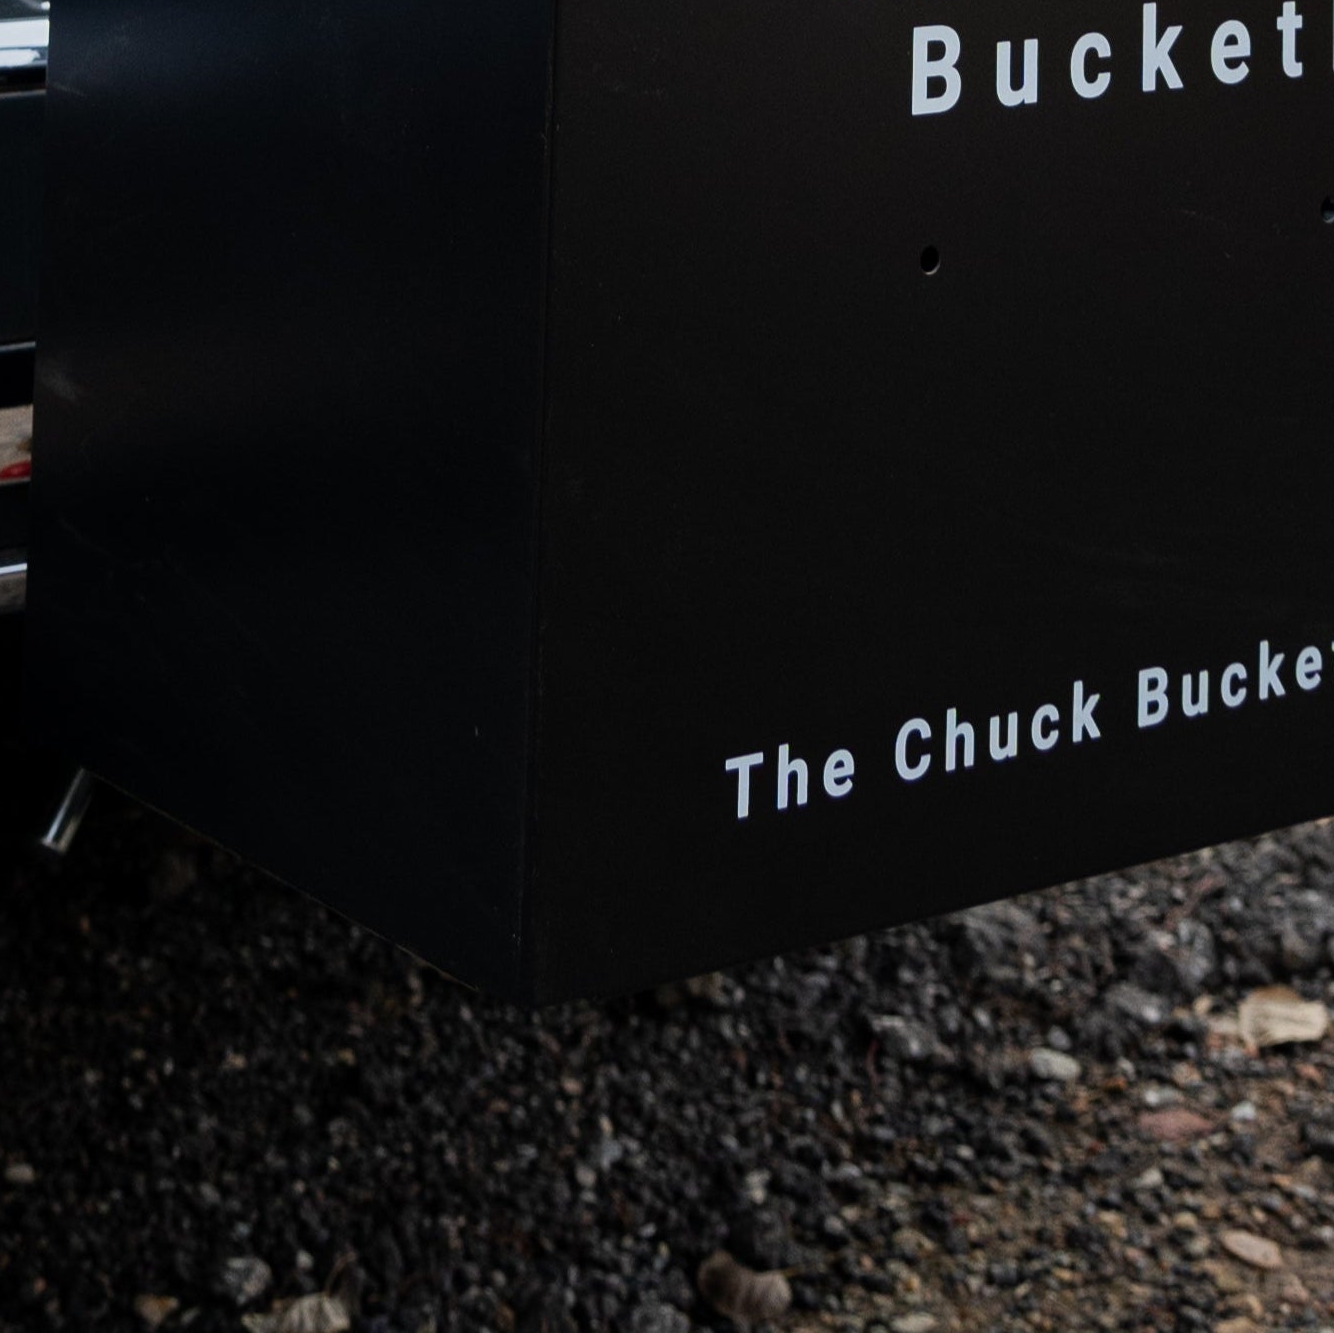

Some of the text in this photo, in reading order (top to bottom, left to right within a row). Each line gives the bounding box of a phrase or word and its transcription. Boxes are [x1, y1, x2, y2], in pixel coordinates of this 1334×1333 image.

[911, 0, 1304, 117] Bucket
[724, 744, 857, 820] The
[893, 679, 1103, 782] Chuck
